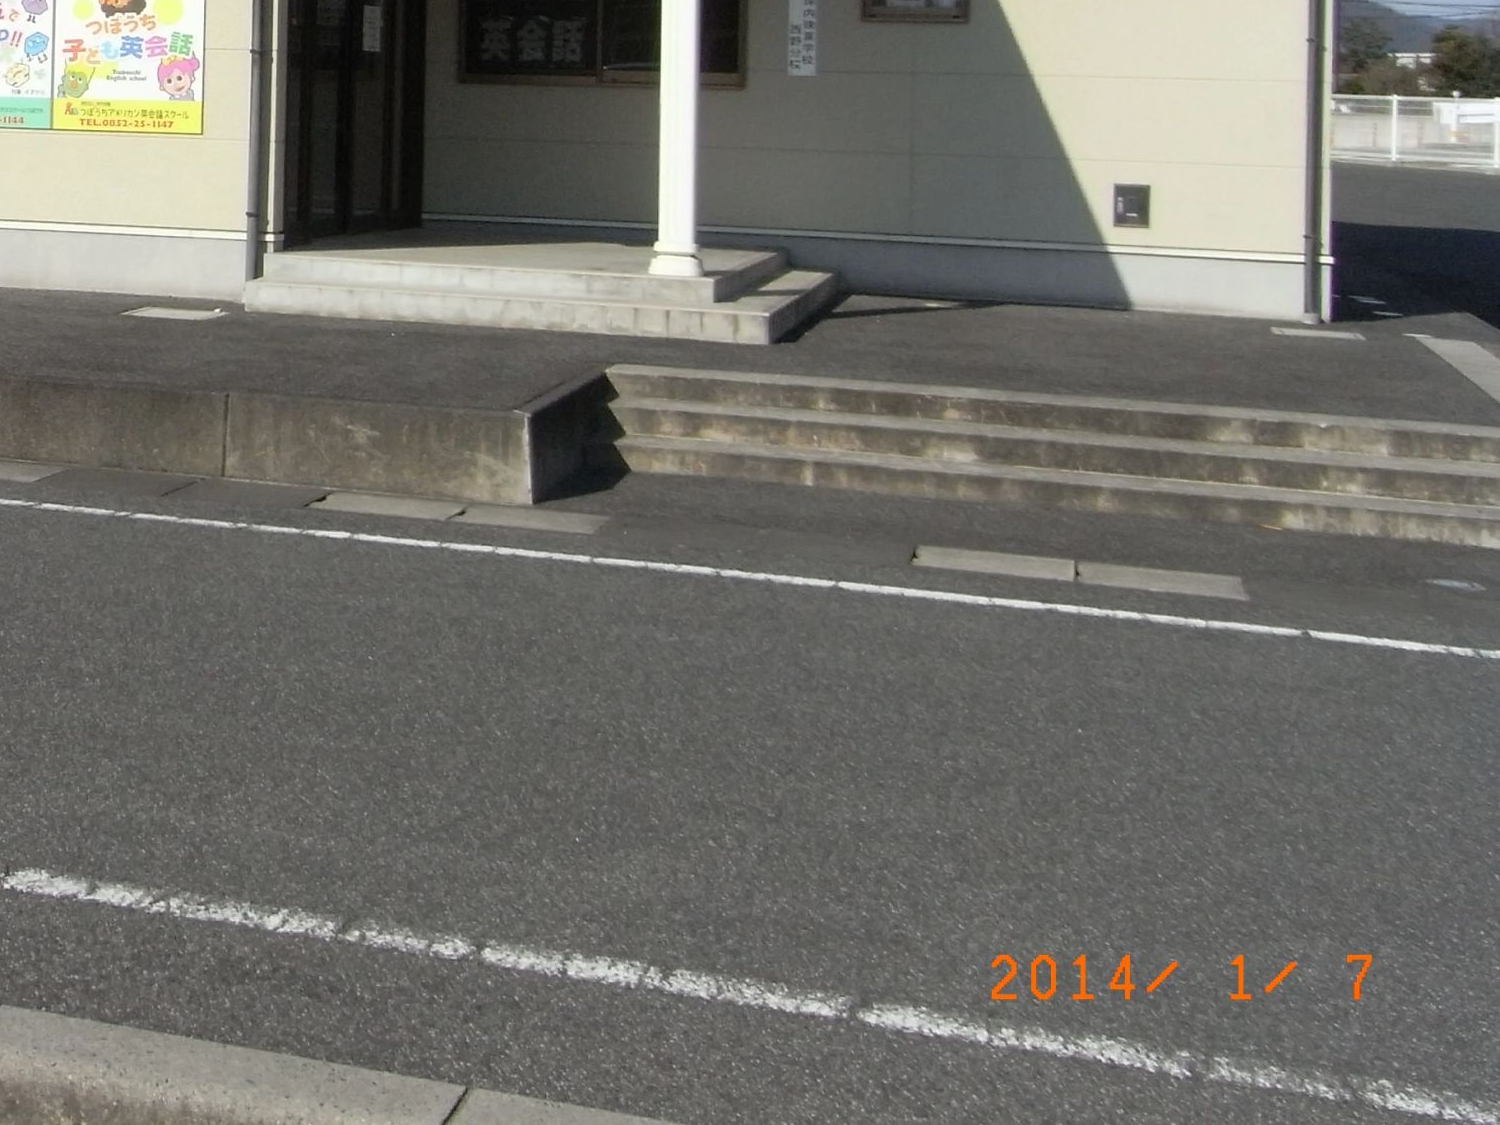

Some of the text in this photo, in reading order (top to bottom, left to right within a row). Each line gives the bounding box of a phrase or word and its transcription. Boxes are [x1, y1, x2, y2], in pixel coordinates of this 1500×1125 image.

[85, 13, 157, 35] つぼうち
[62, 31, 194, 64] 子ども英会話
